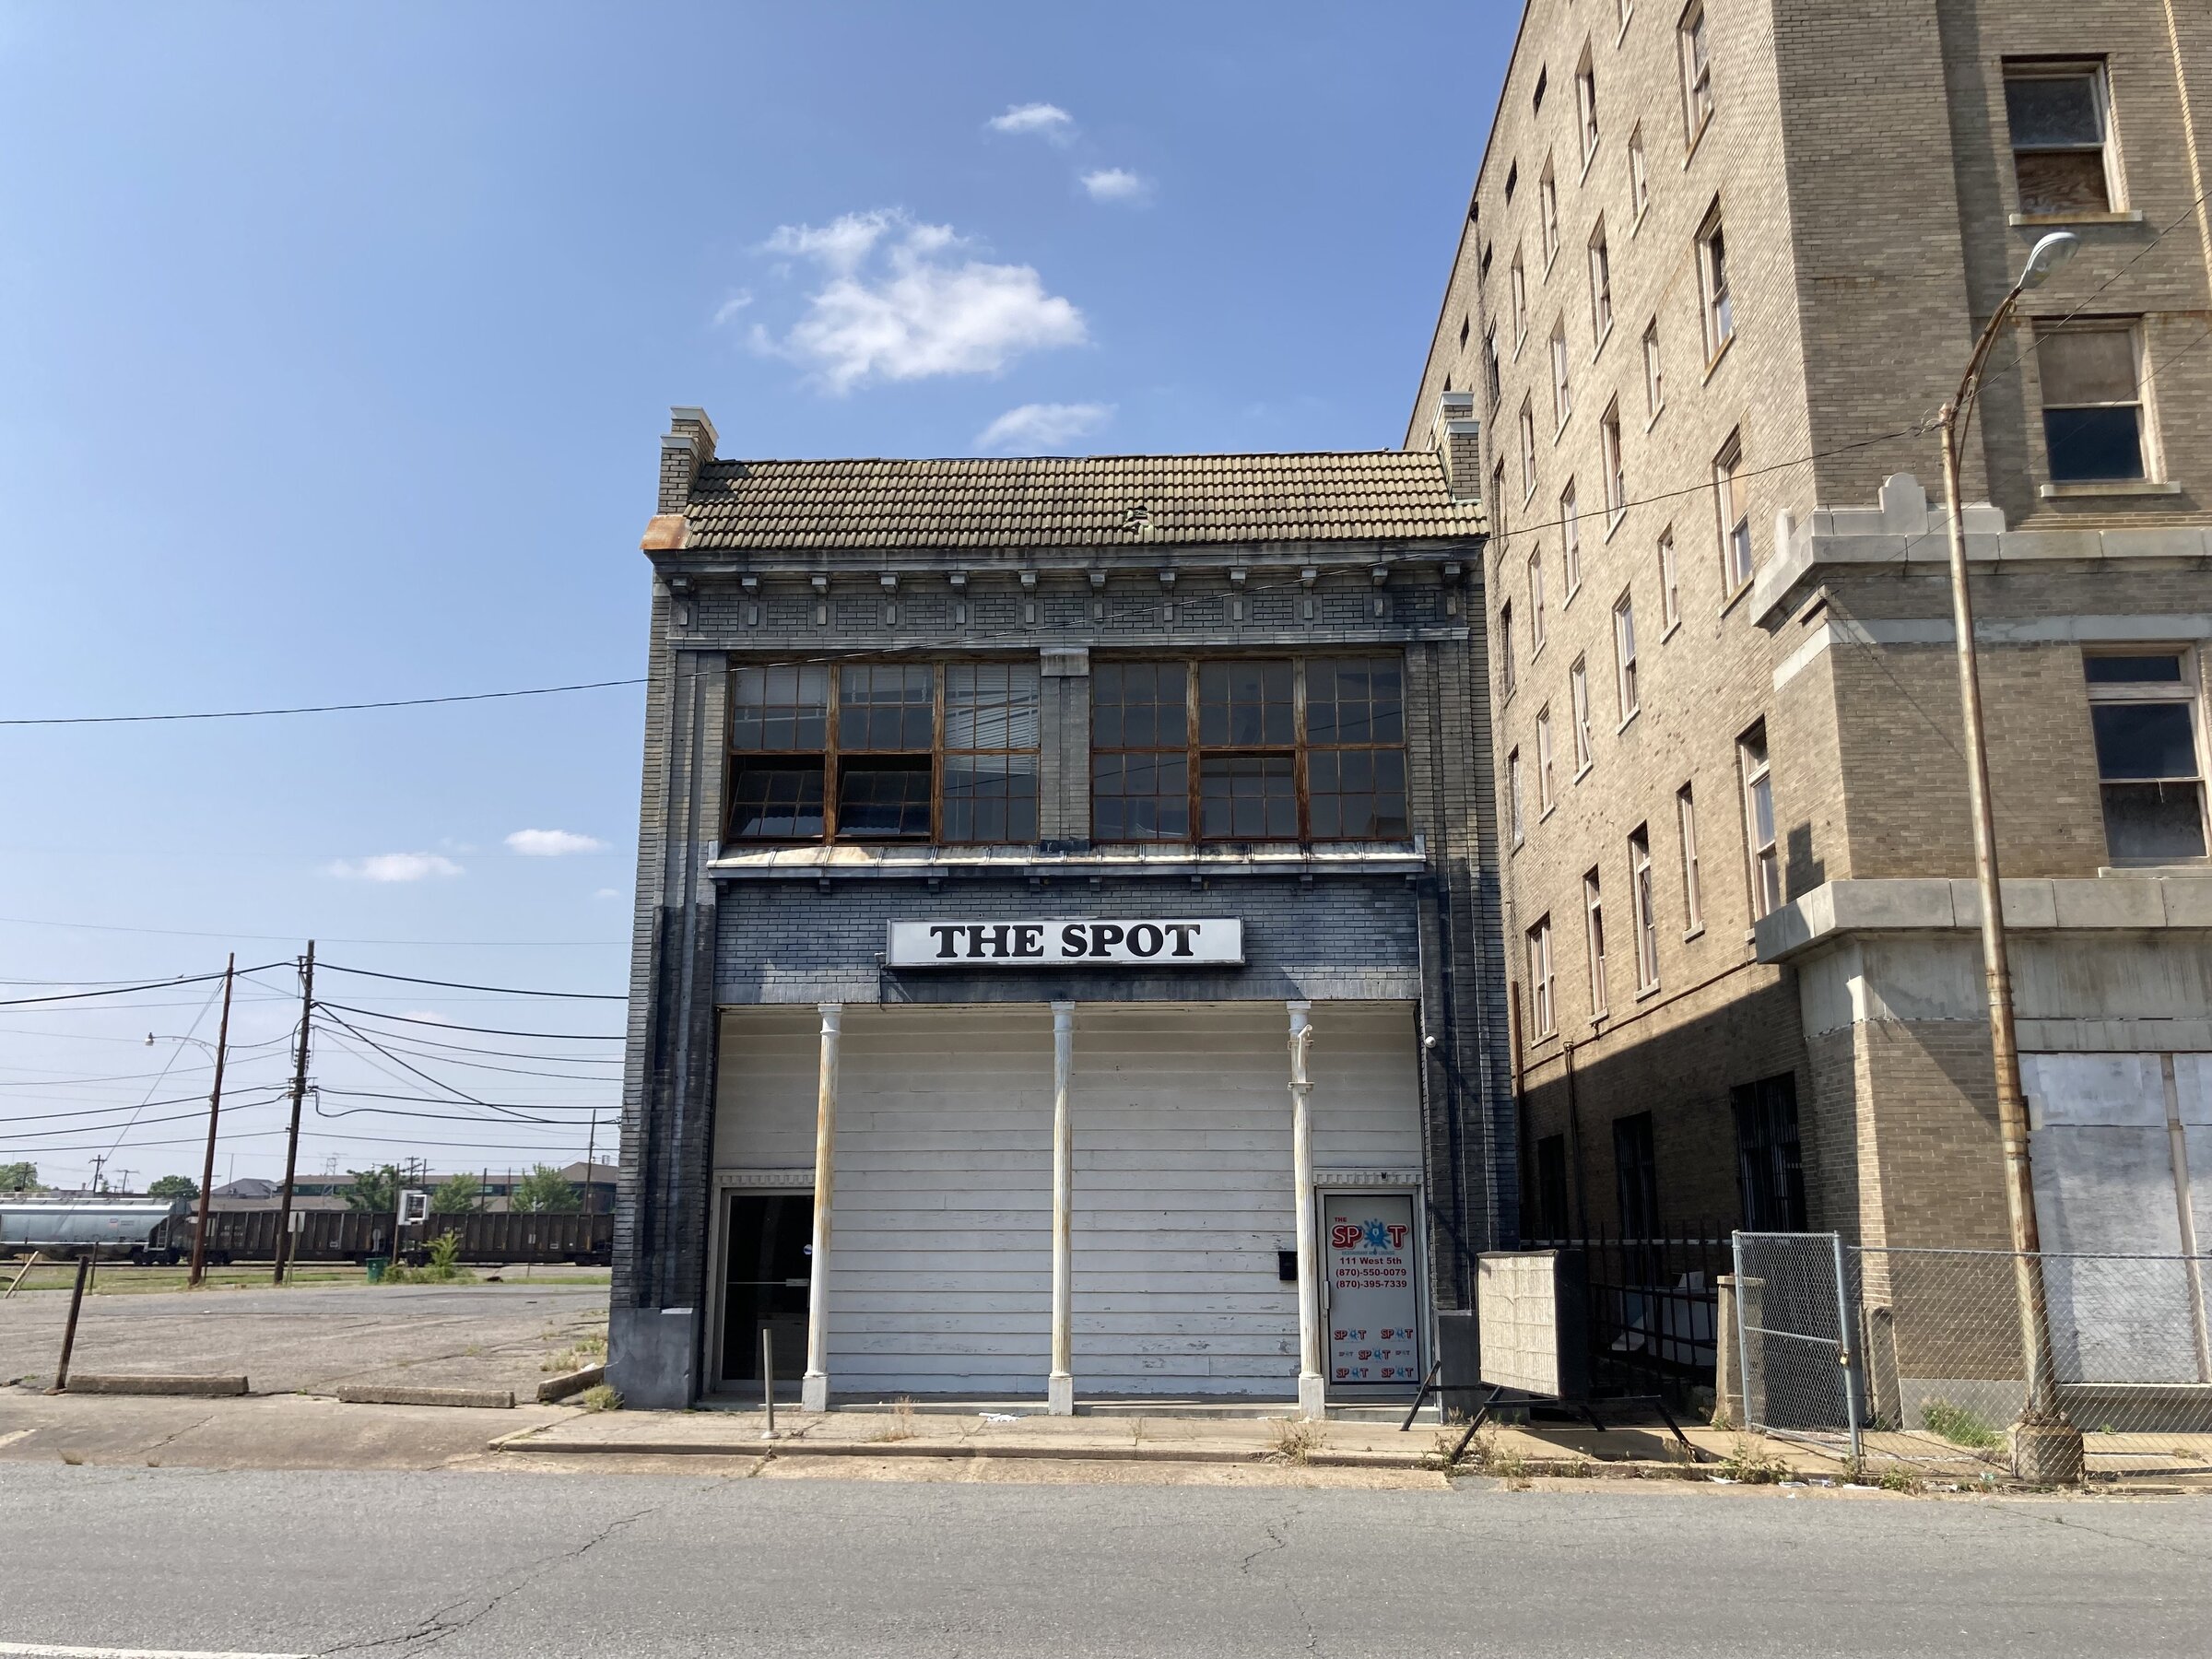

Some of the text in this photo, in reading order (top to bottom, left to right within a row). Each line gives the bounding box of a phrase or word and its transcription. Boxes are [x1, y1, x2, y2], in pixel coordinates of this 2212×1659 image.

[930, 924, 1201, 958] THE SPOT
[1335, 1268, 1406, 1277] (870)-550-0079
[1336, 1280, 1407, 1288] (870)-395-7339
